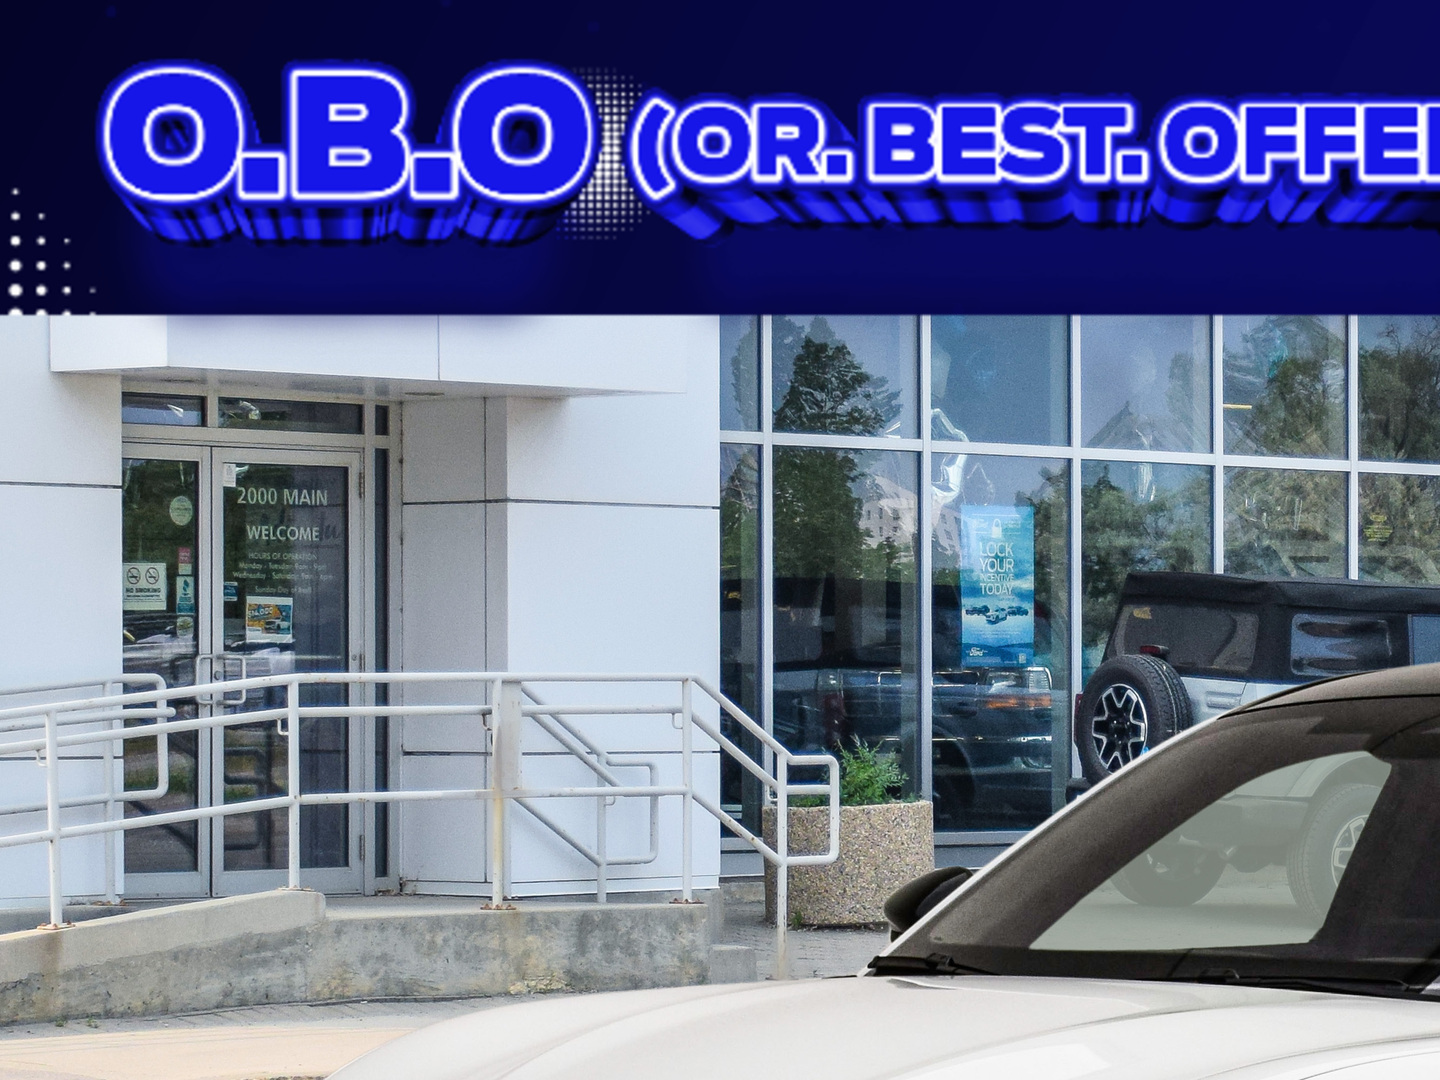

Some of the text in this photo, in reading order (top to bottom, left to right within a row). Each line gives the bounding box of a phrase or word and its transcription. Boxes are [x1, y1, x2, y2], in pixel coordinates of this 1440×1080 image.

[237, 486, 328, 506] 2000 MAIN
[246, 524, 320, 541] WELCOME
[980, 541, 1014, 557] LOCK
[980, 558, 1014, 572] YOUR
[980, 583, 1014, 595] TODAY
